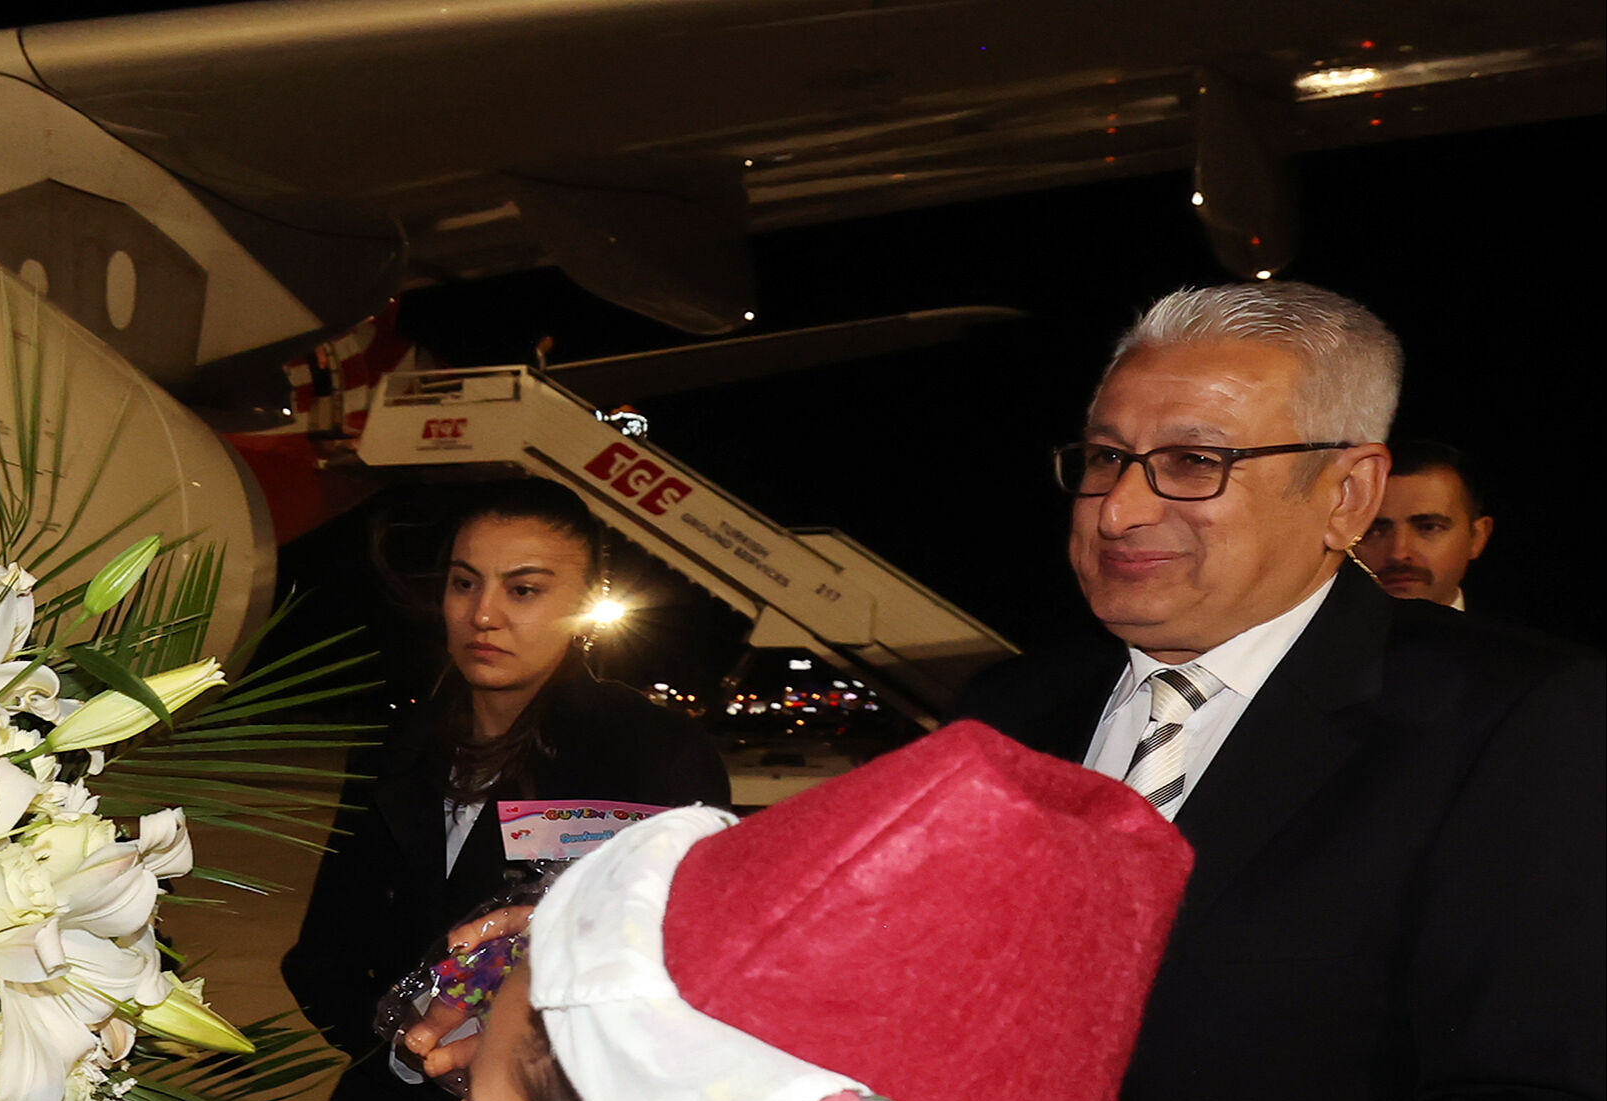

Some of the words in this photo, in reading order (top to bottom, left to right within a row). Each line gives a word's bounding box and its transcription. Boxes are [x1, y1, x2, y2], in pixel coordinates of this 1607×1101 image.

[583, 441, 693, 516] TGS
[680, 512, 735, 550] GROUND
[733, 546, 791, 588] SERVICES
